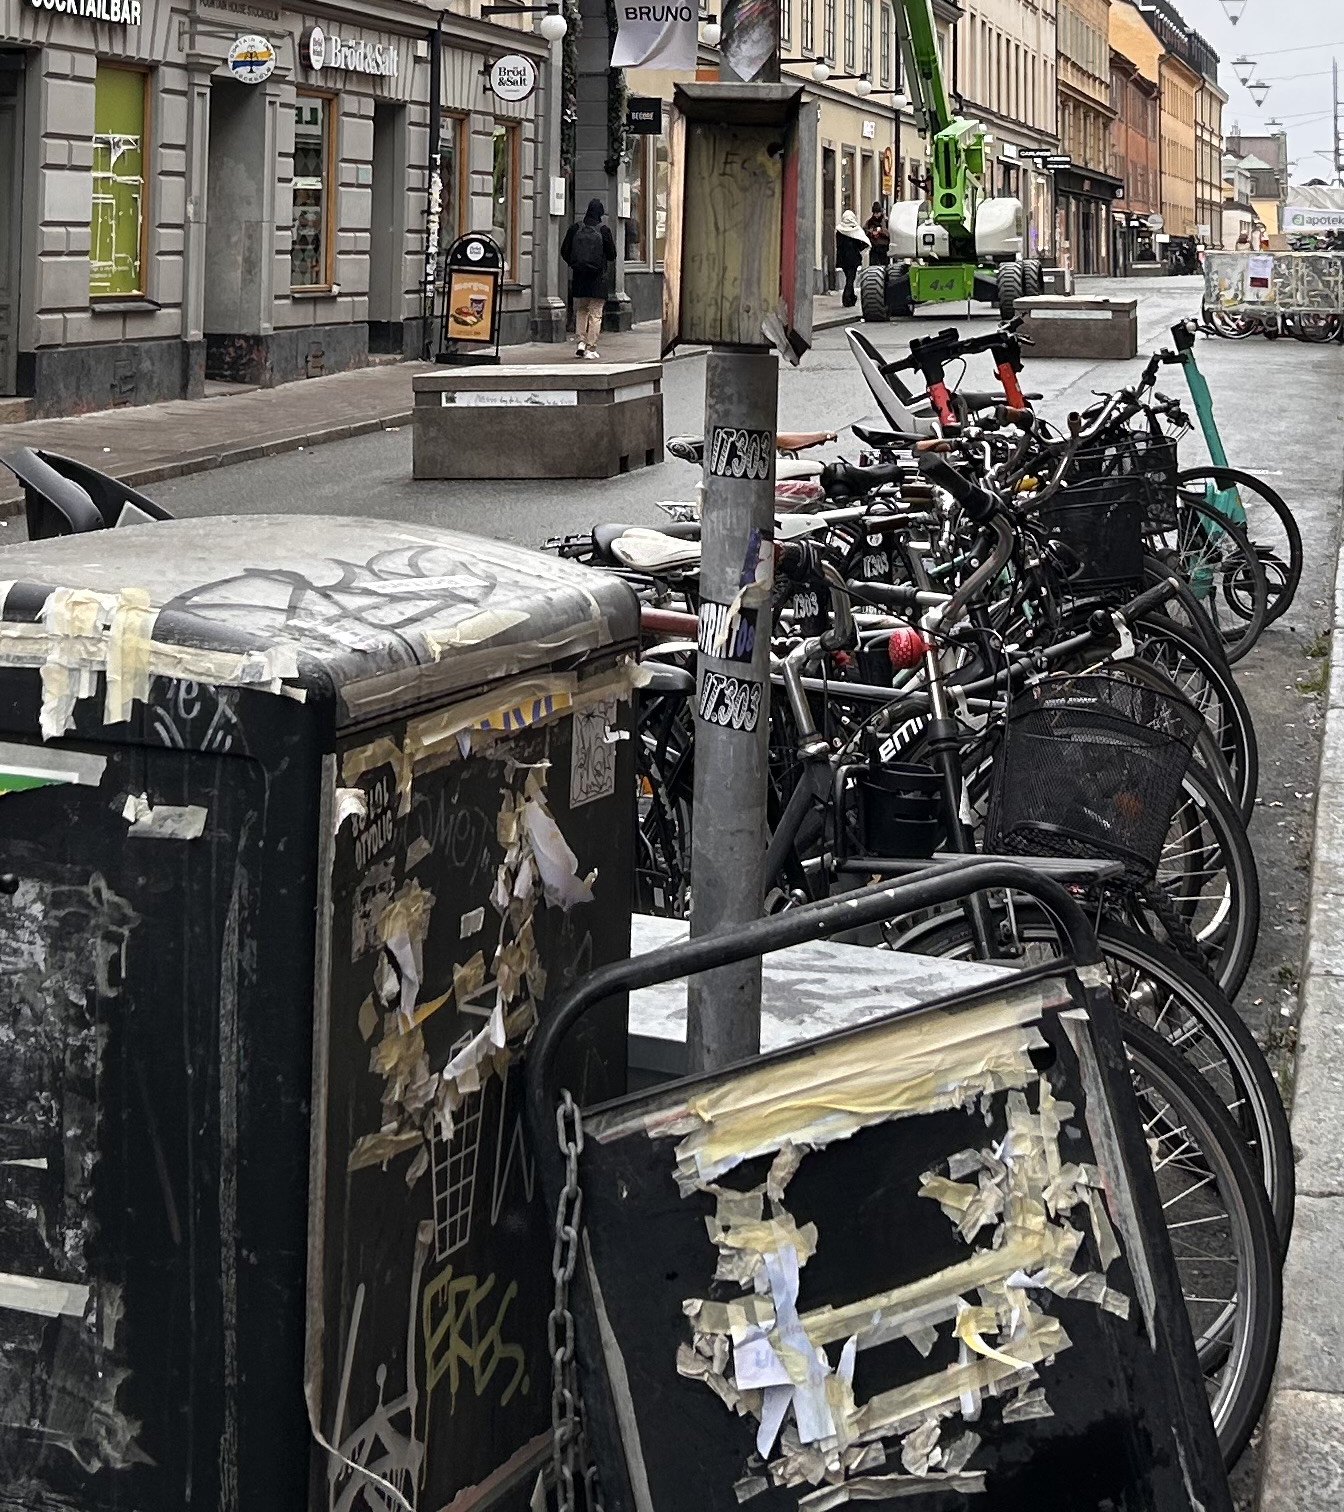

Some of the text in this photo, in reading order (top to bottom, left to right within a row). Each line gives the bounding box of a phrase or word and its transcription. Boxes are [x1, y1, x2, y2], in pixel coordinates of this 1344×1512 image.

[624, 5, 692, 22] BRUNO
[497, 66, 527, 77] Bröd
[497, 76, 528, 87] &Salt
